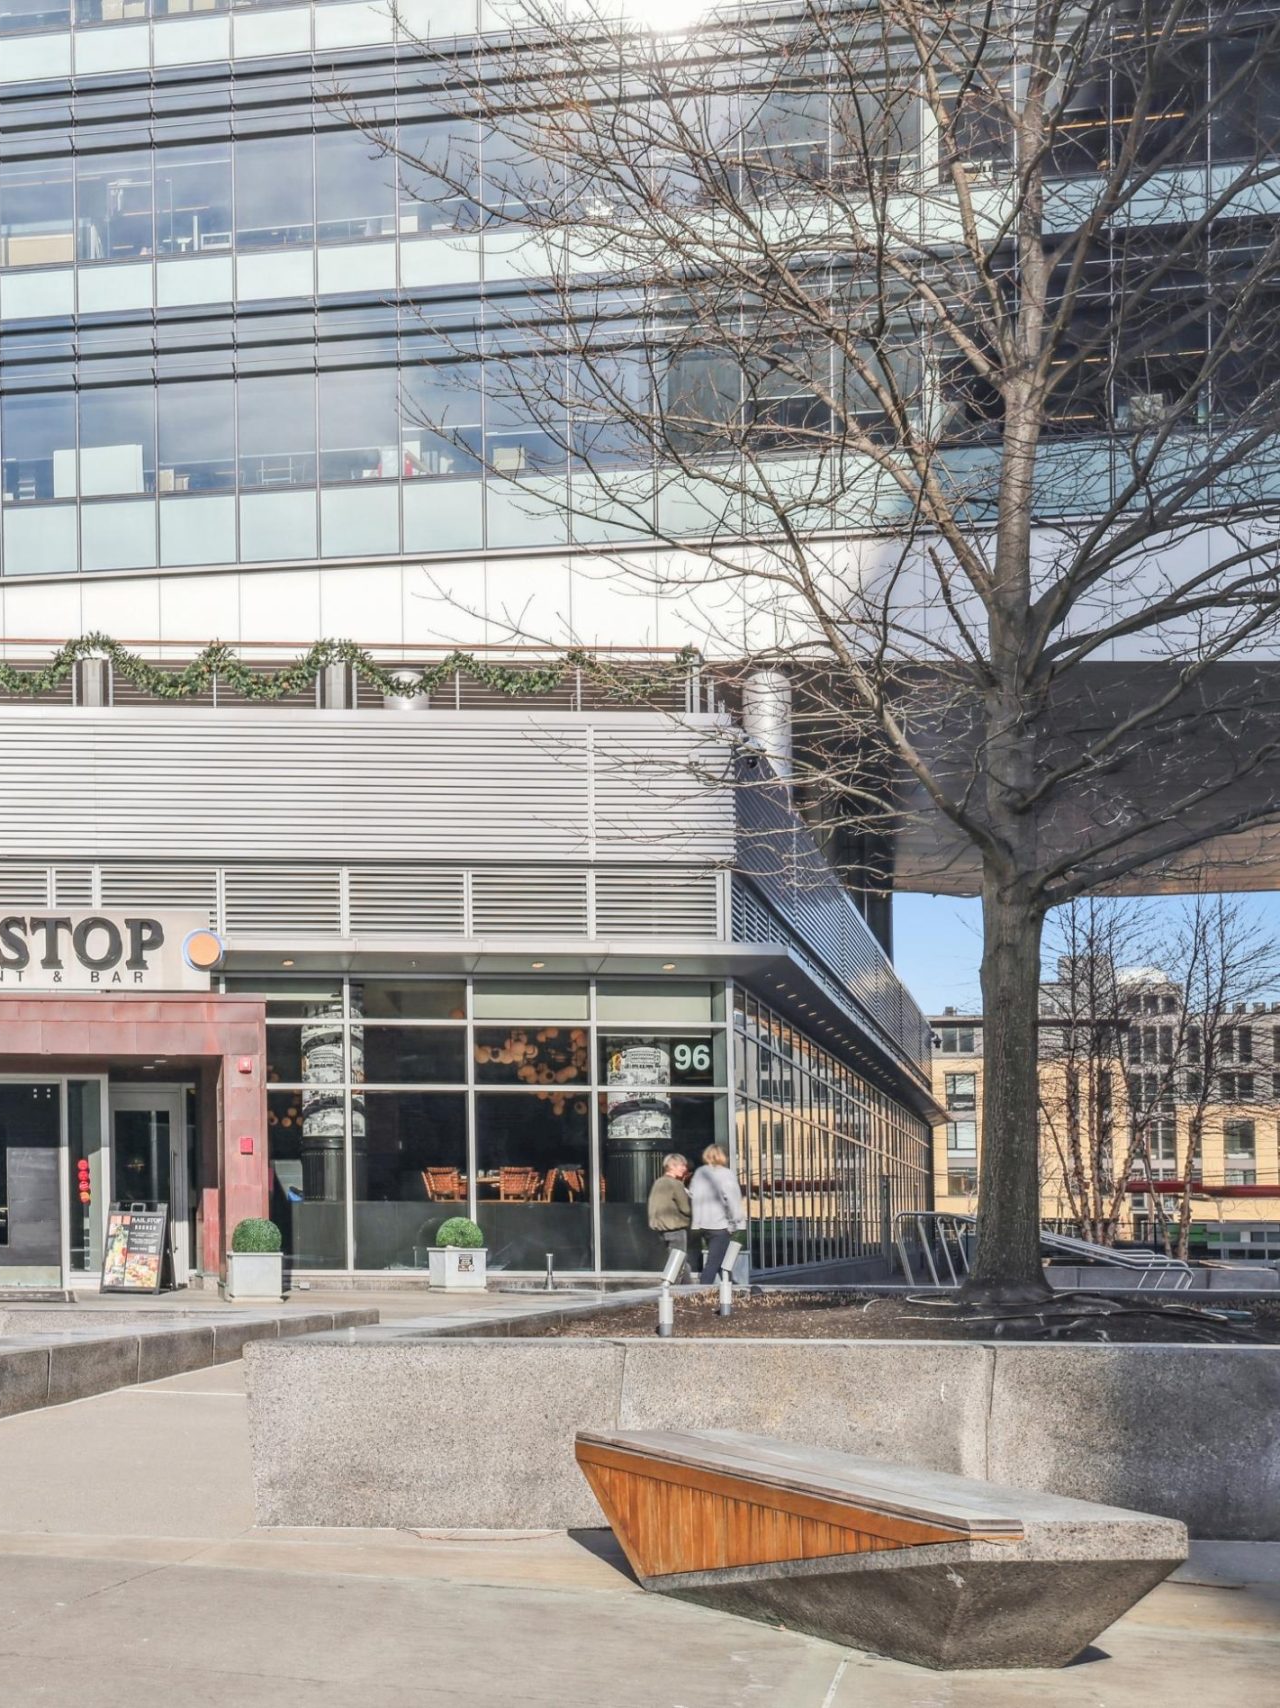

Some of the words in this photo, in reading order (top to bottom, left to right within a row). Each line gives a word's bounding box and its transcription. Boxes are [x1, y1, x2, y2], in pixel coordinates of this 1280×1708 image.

[52, 970, 63, 983] &
[91, 971, 144, 984] BAR
[673, 1043, 711, 1071] 96
